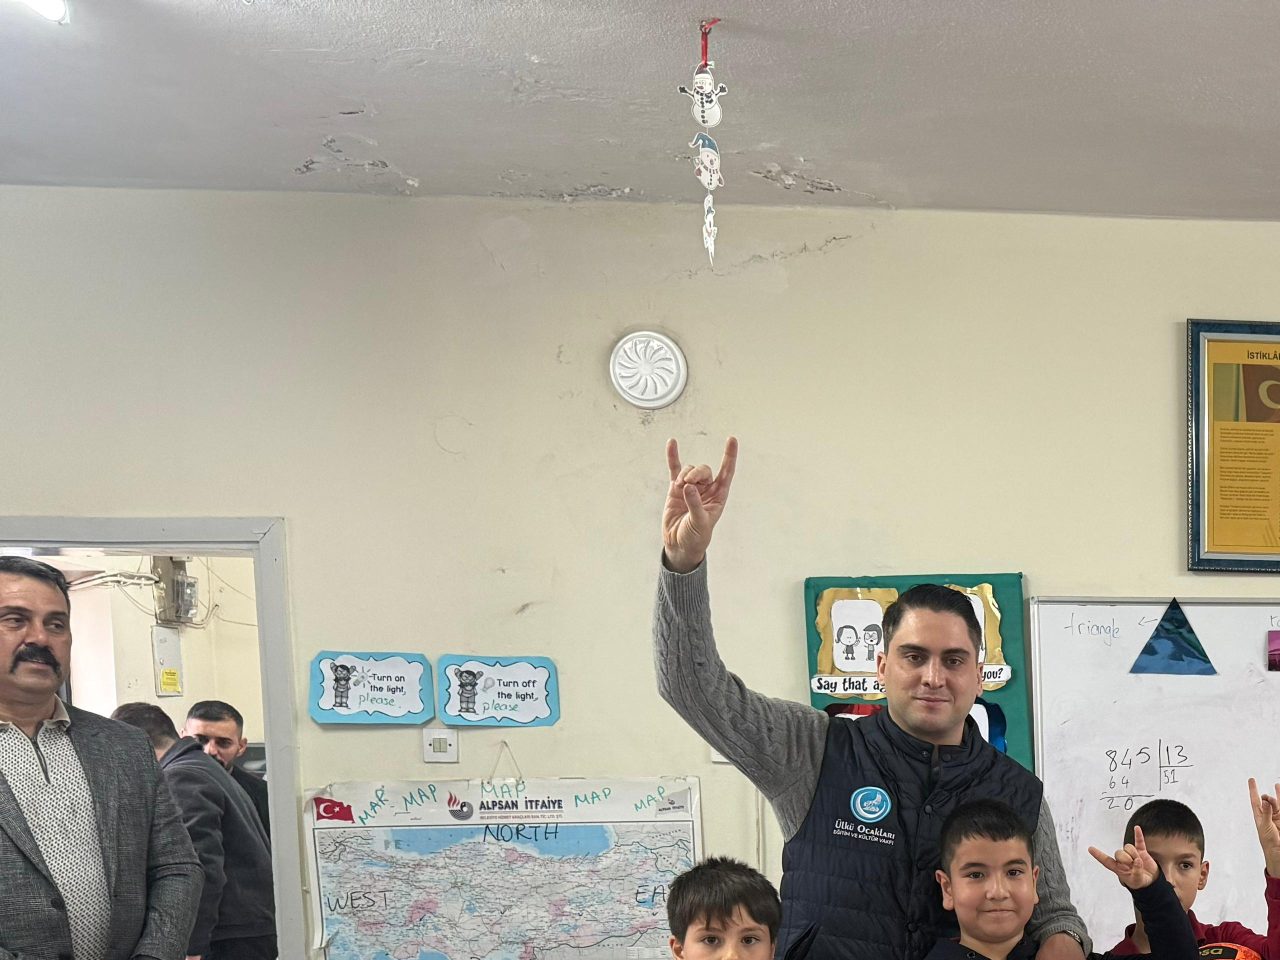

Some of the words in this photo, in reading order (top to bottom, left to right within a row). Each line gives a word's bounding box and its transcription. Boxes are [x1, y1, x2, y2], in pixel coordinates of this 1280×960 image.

[1064, 613, 1120, 647] triangle
[373, 673, 396, 683] Turn
[496, 678, 519, 688] Turn
[521, 678, 538, 688] off
[816, 678, 837, 693] Say
[842, 676, 868, 692] that
[370, 683, 385, 693] the
[497, 690, 513, 700] the
[1106, 746, 1151, 773] 845
[1166, 745, 1188, 766] 13
[402, 783, 437, 812] MAP
[481, 781, 525, 799] MAP
[574, 787, 611, 808] MAP
[634, 786, 666, 812] MAP
[479, 799, 519, 810] ALPSAN
[524, 796, 563, 810] İTFAİYE
[483, 823, 559, 843] NORTH
[834, 819, 855, 831] Ülkü
[327, 890, 392, 912] WEST
[636, 884, 666, 903] EA
